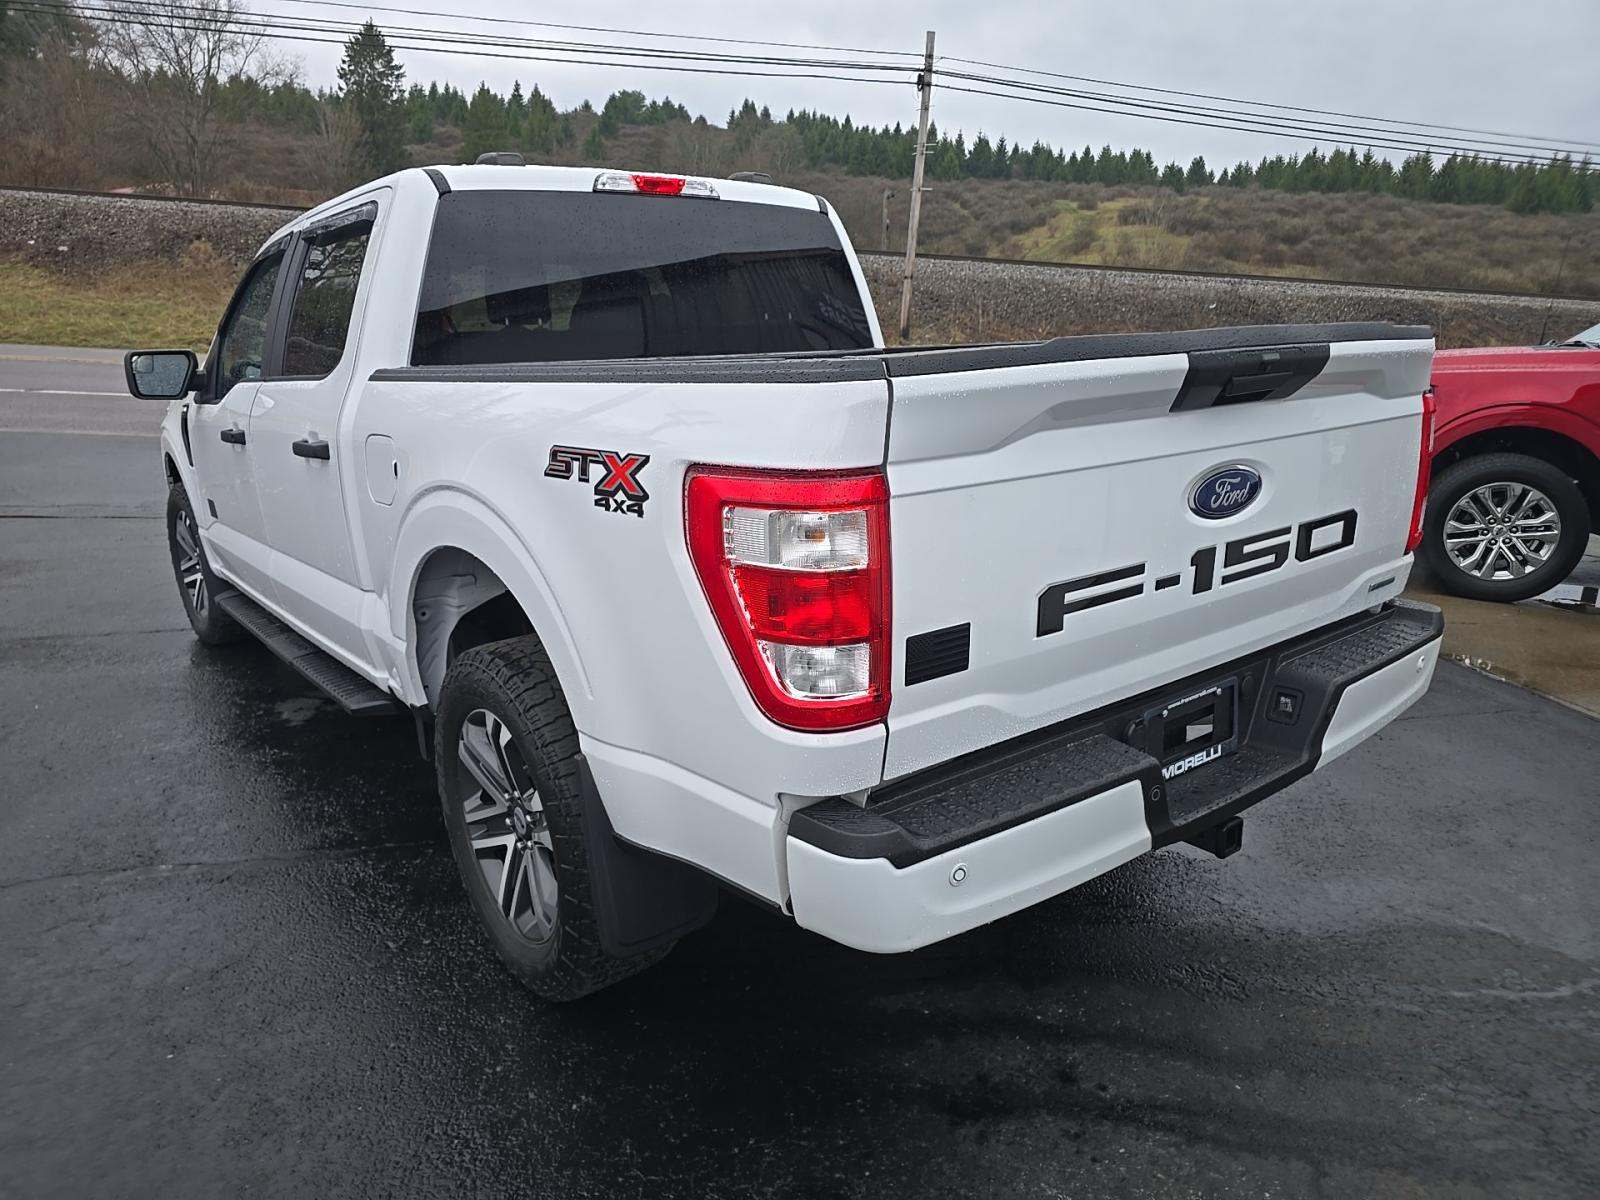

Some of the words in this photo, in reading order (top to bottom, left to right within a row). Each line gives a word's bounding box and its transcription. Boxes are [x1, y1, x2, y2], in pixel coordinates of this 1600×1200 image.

[544, 445, 650, 503] STX
[1211, 477, 1250, 508] Ford
[1036, 508, 1357, 637] F-150
[1162, 744, 1222, 780] MORELLI
